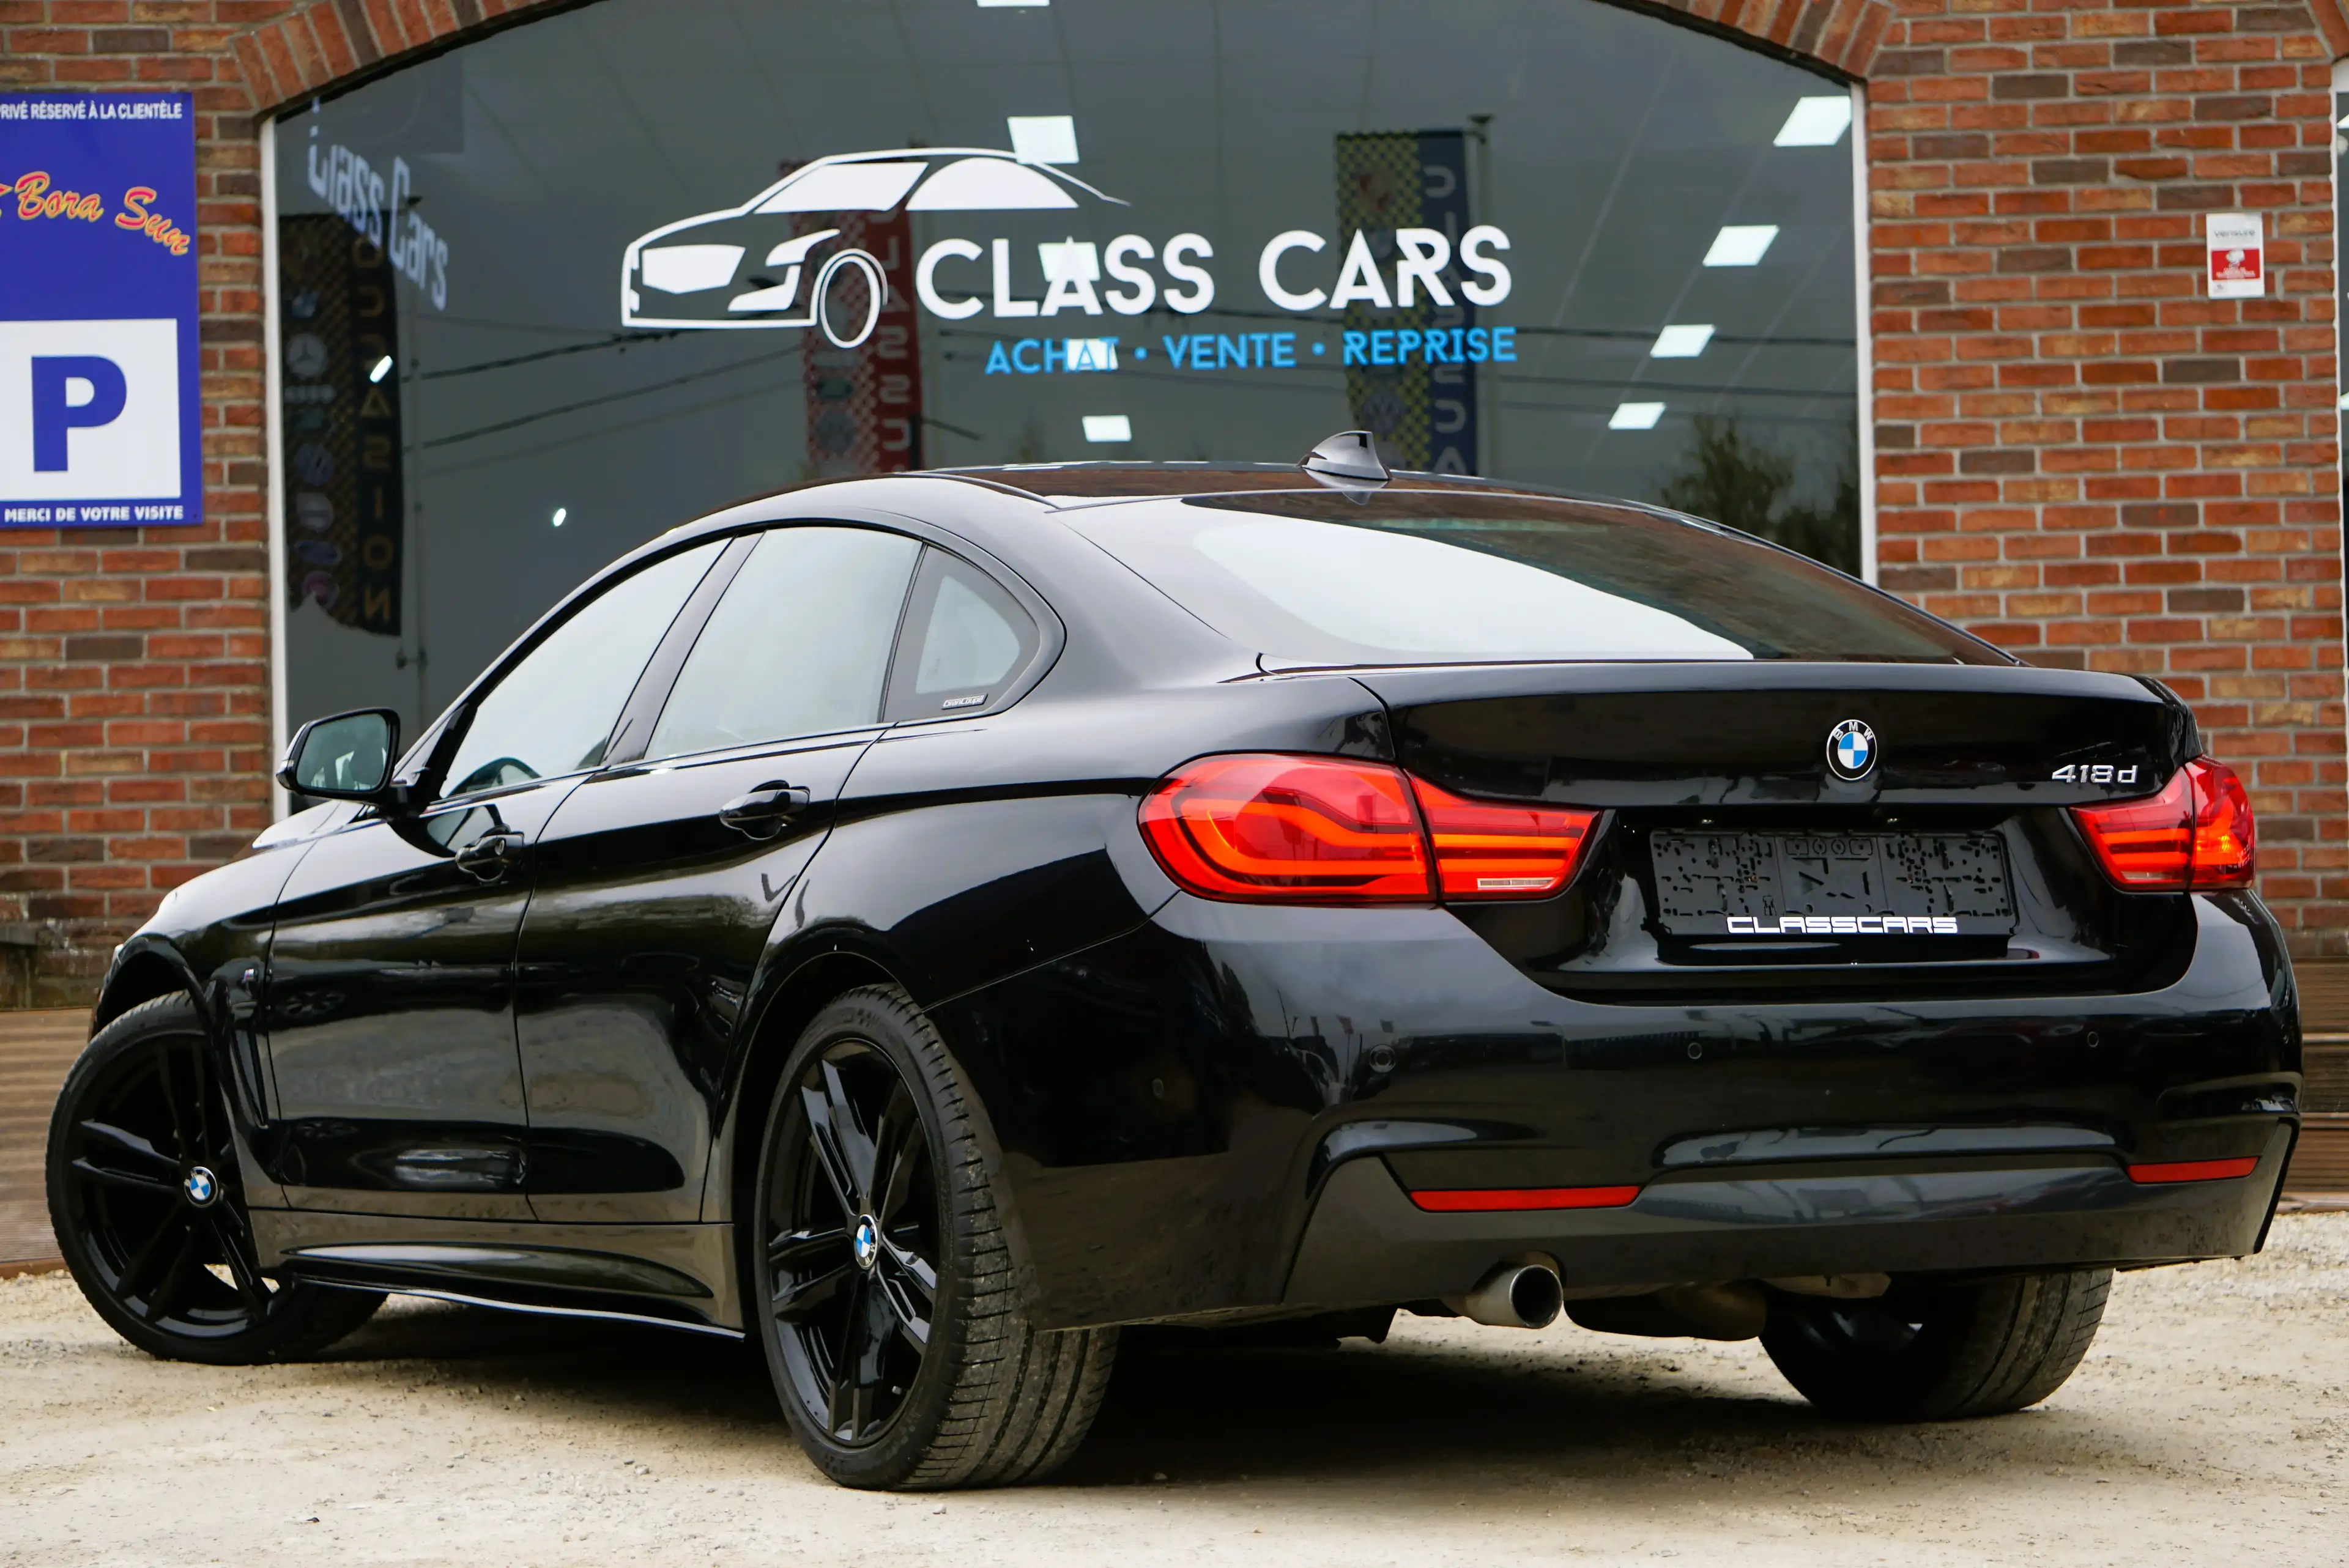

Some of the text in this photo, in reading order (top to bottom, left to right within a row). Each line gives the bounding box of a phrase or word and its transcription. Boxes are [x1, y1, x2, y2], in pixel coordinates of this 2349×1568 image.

[0, 99, 183, 120] RIVÉ RÉSERVÉ À LA CLIENTÈLE
[15, 171, 104, 222] Bora
[114, 186, 191, 256] Sun
[388, 155, 448, 312] Cars
[916, 225, 1512, 320] CLASS CARS
[984, 327, 1518, 375] ACHAT VENTE REPRISE
[31, 355, 127, 472] P
[4, 505, 184, 522] MERCI DE VOTRE VISITE
[1833, 722, 1874, 741] BMW
[1726, 917, 1958, 934] CLASSCARS
